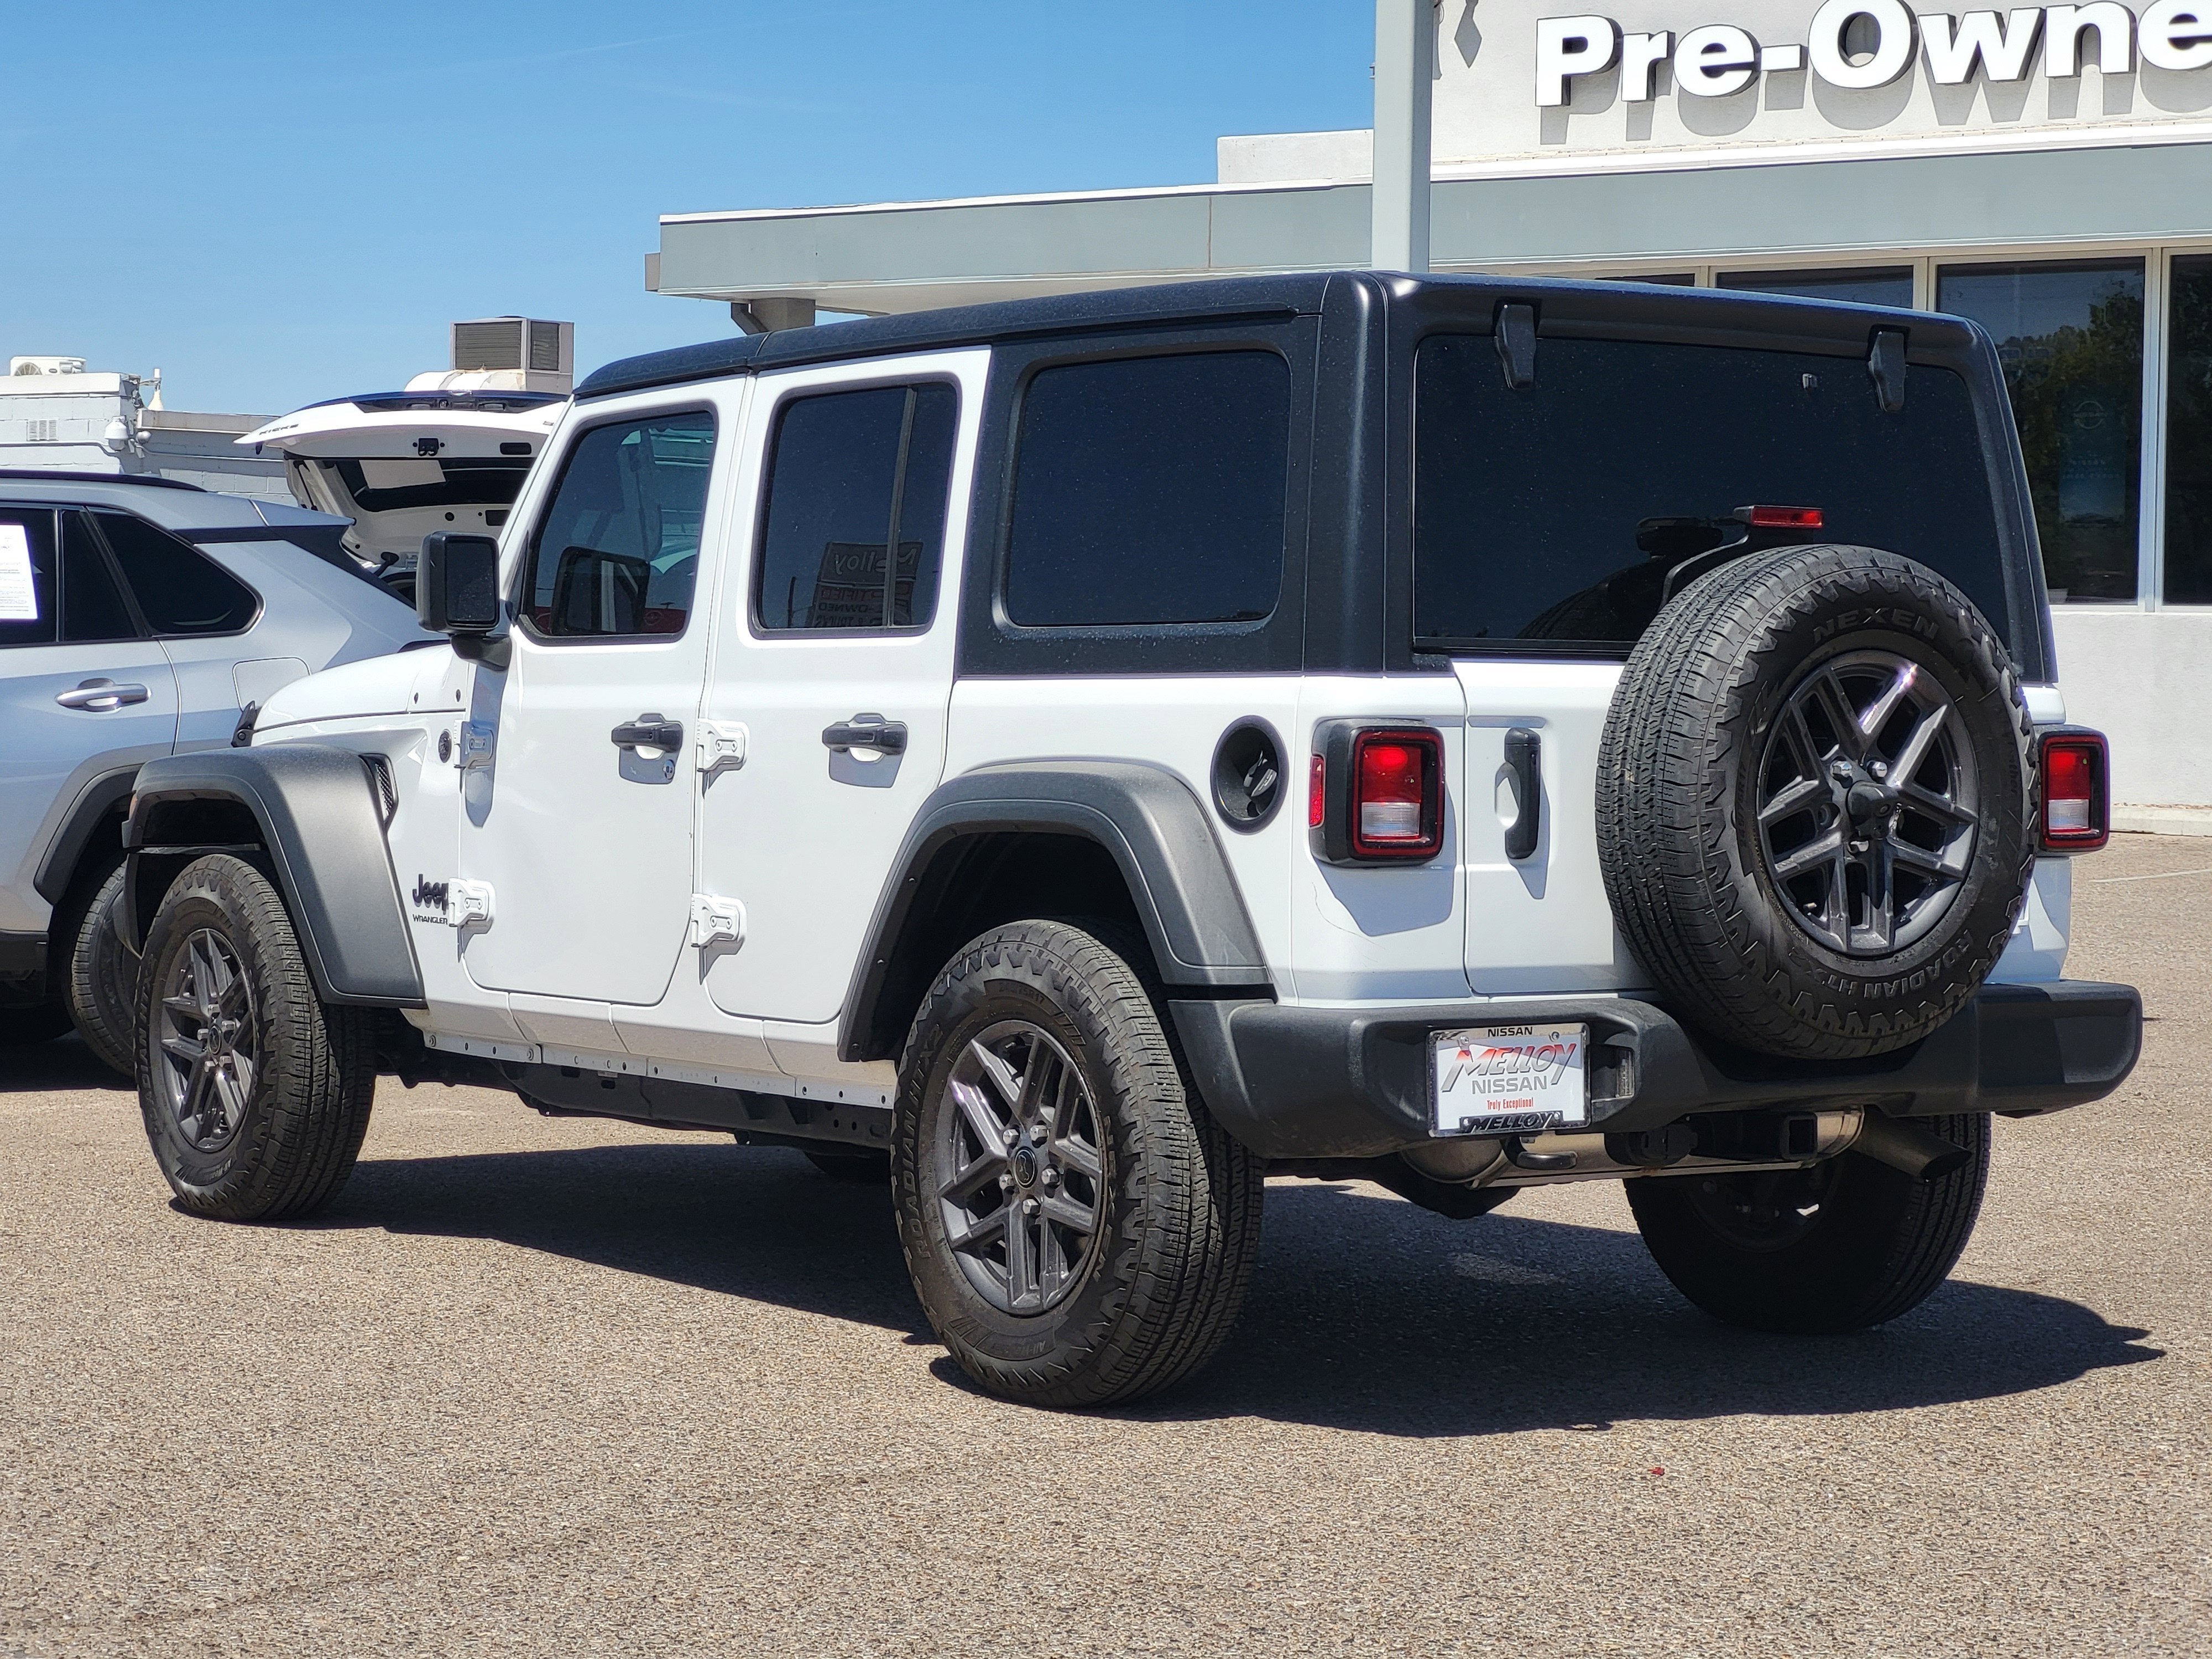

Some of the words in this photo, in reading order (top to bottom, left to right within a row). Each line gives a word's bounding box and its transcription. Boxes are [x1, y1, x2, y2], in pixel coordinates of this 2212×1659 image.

[1813, 608, 1940, 644] NEXEN
[413, 914, 448, 925] WRANGLER
[1864, 929, 1974, 999] ROADIAN
[1488, 1026, 1533, 1037] NISSAN
[1441, 1043, 1576, 1093] MELLOY
[1472, 1076, 1547, 1095] NISSAN
[1486, 1099, 1501, 1111] Truly
[1503, 1097, 1534, 1109] Exceptional
[1467, 1112, 1554, 1134] MELLOY
[902, 1109, 931, 1259] ROADIAN
